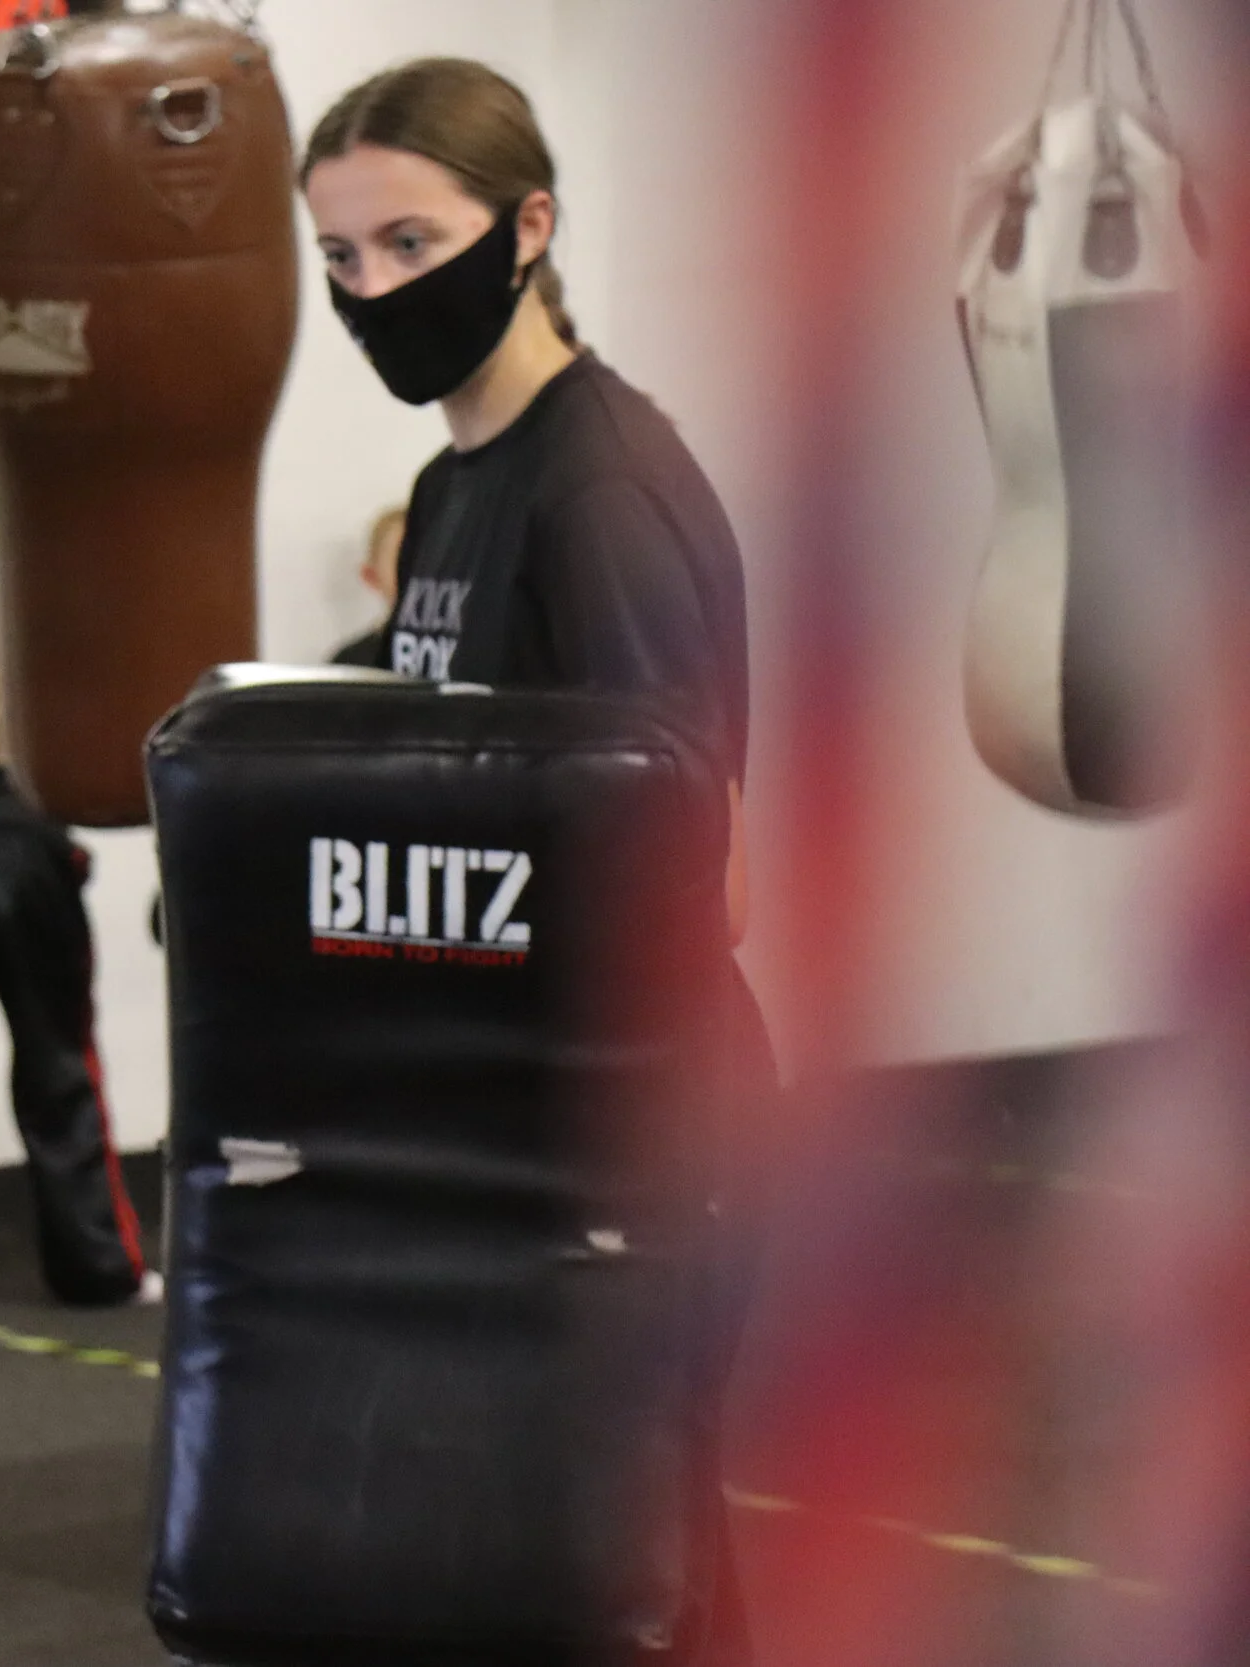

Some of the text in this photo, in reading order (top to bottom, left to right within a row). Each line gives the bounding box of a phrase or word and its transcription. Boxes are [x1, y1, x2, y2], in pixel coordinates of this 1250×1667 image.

[310, 836, 532, 943] BLITZ
[311, 936, 394, 957] BORN
[402, 943, 439, 963] TO
